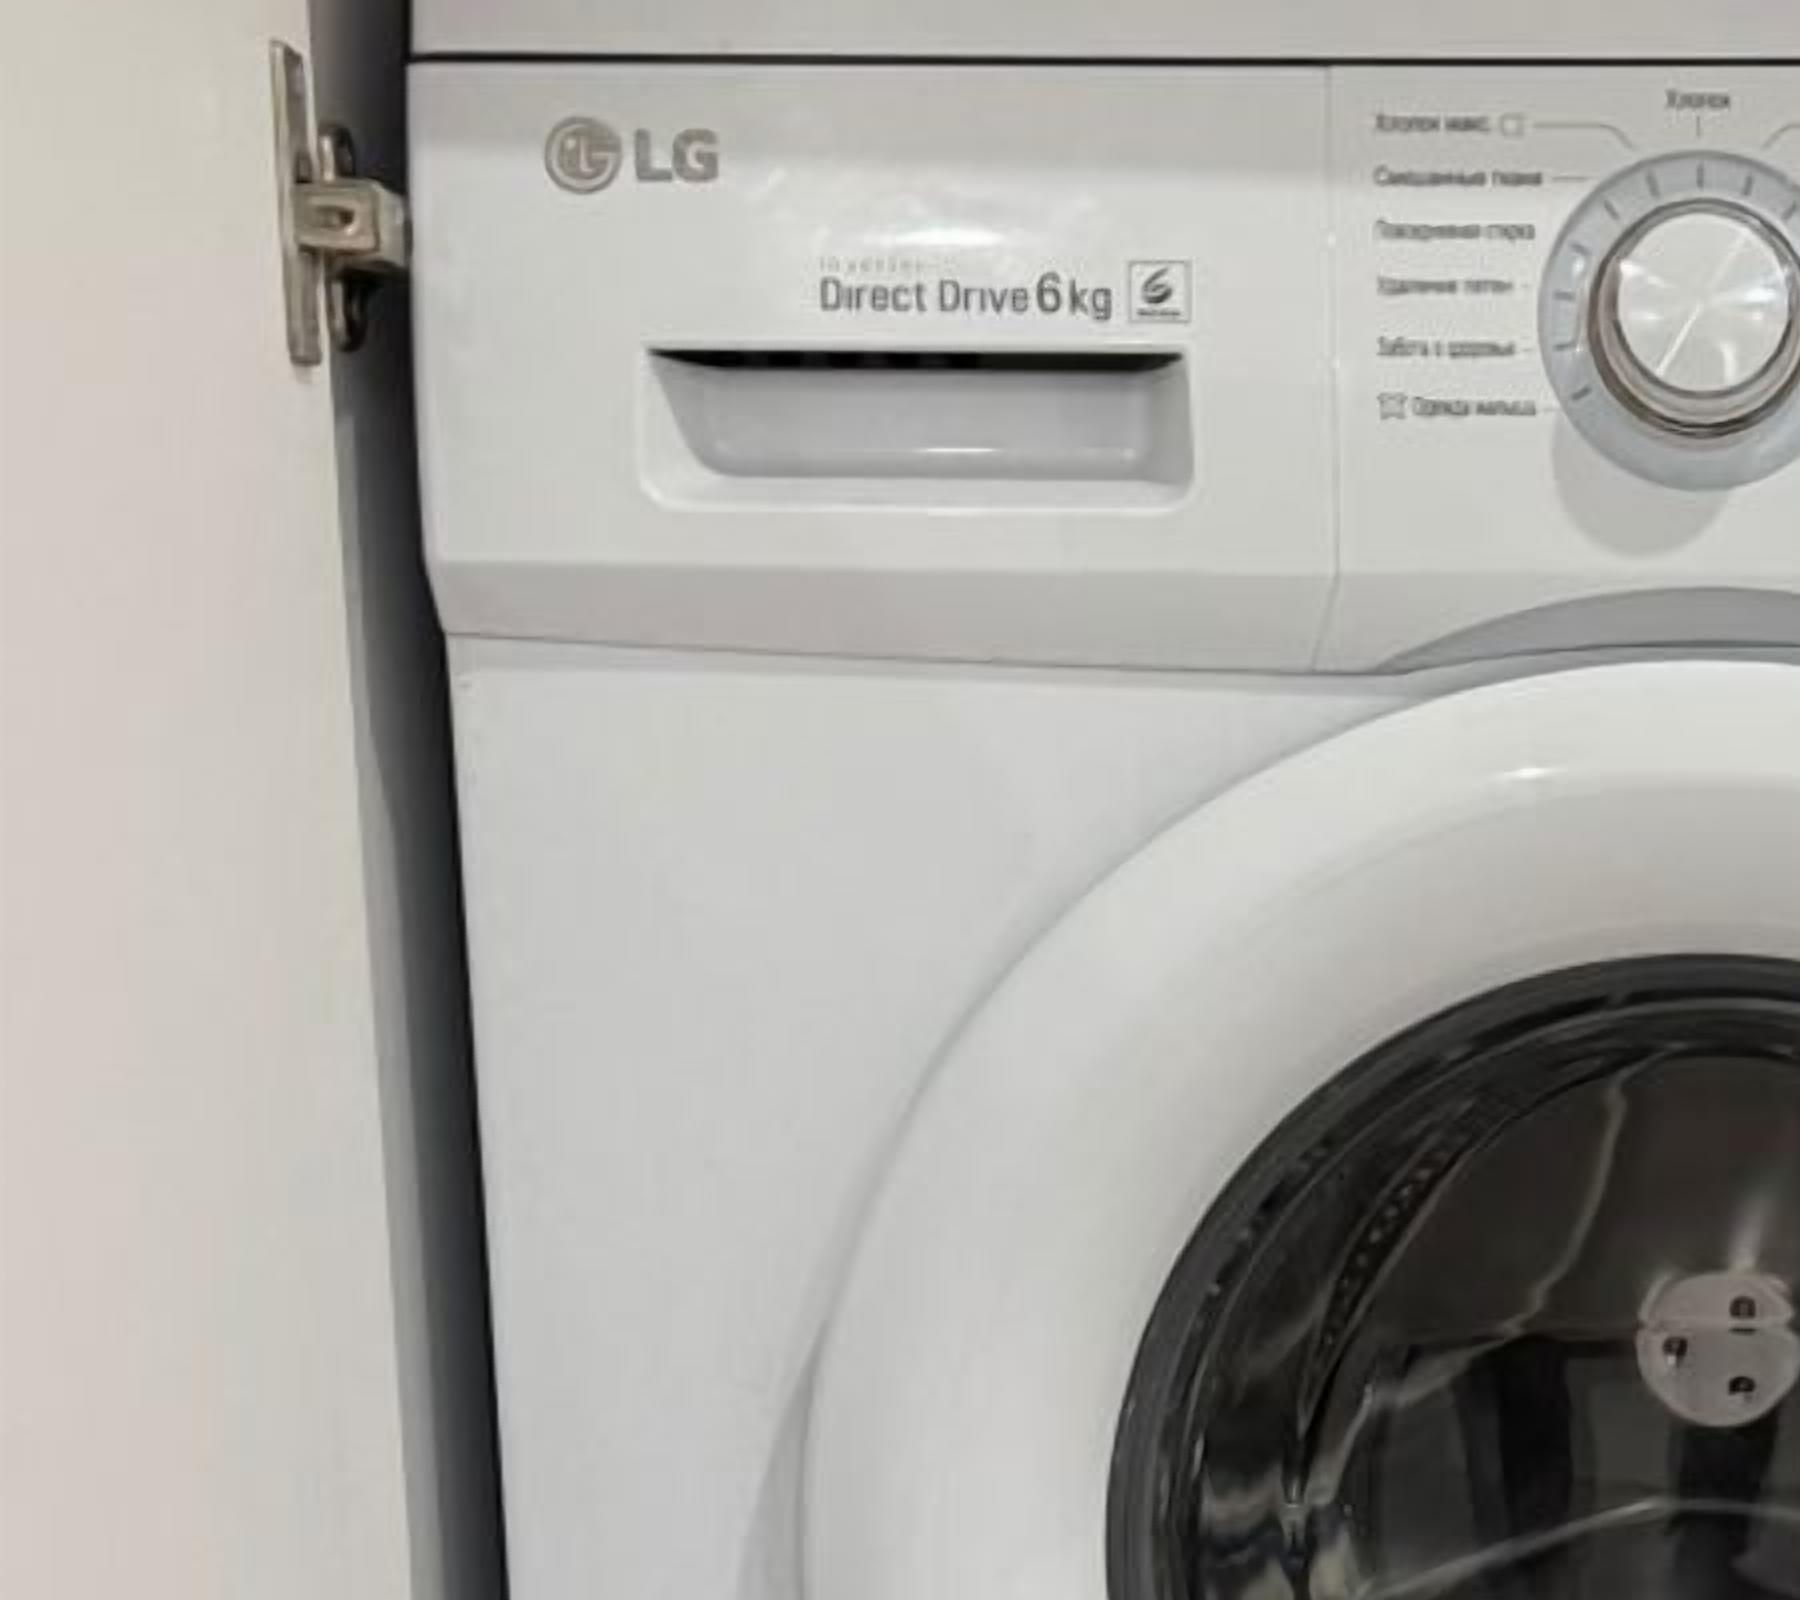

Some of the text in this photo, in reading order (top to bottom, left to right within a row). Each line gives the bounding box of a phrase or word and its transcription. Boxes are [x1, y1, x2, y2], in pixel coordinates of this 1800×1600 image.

[633, 127, 719, 183] LG
[821, 277, 927, 312] Direct
[938, 279, 1030, 312] Drive
